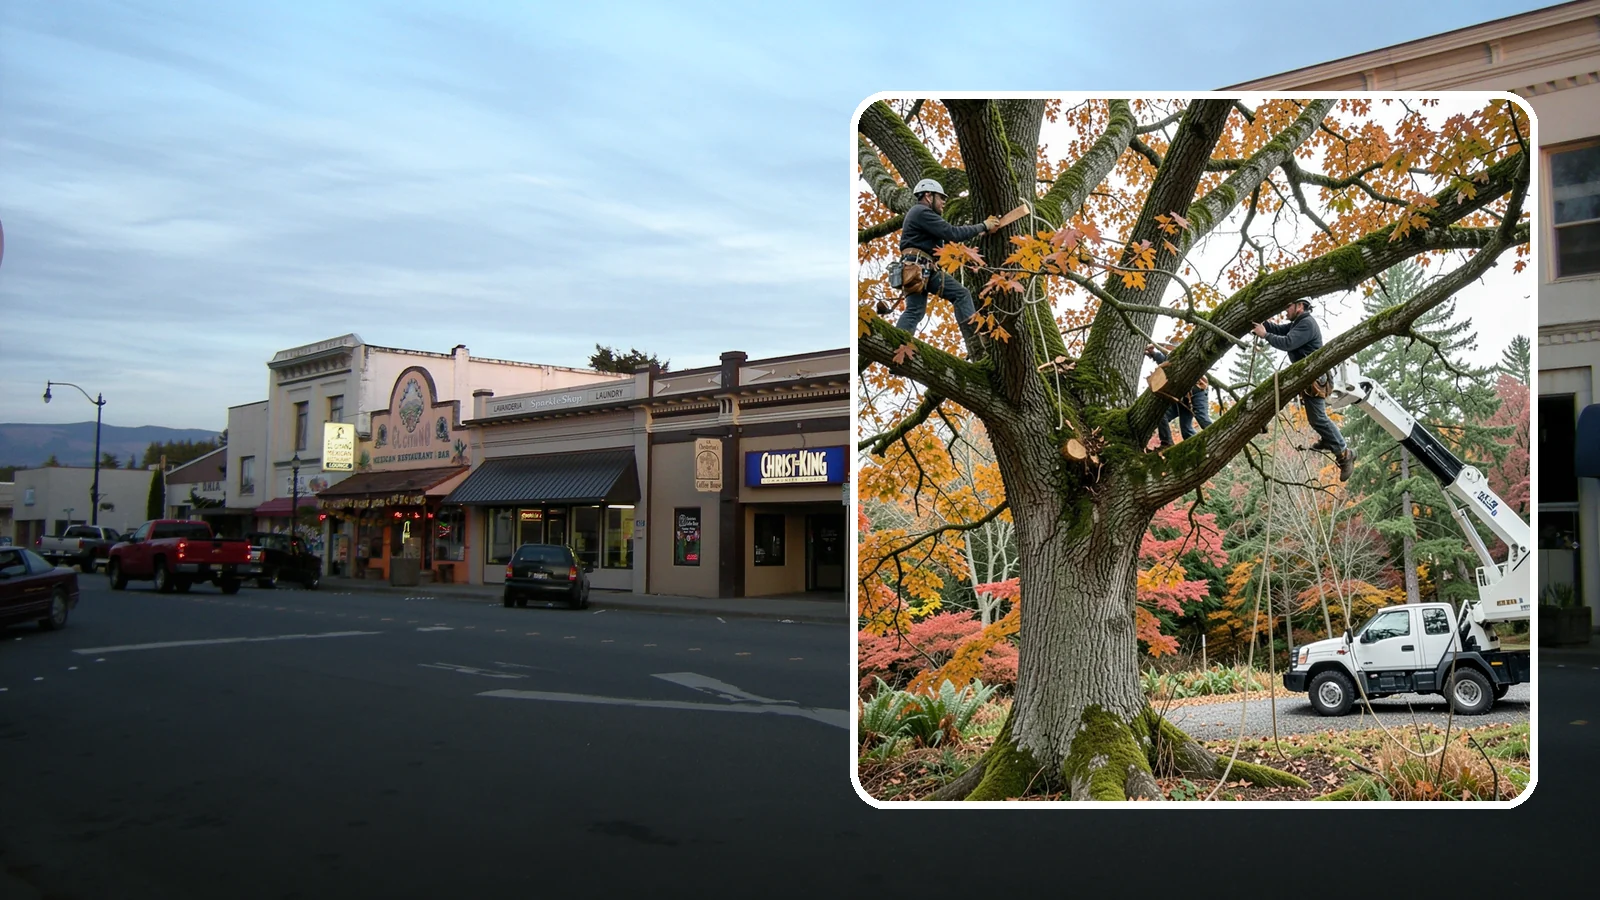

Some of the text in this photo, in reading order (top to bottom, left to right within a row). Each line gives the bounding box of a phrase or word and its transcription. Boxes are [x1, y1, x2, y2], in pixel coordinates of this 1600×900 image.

[595, 389, 624, 400] LAUNDRY
[530, 394, 582, 408] Sparkle Shop
[493, 402, 523, 413] LAVANDERIA
[373, 455, 396, 464] MEXICAN
[397, 451, 434, 462] RESTAURANT
[438, 450, 450, 459] BAR
[709, 481, 722, 489] House
